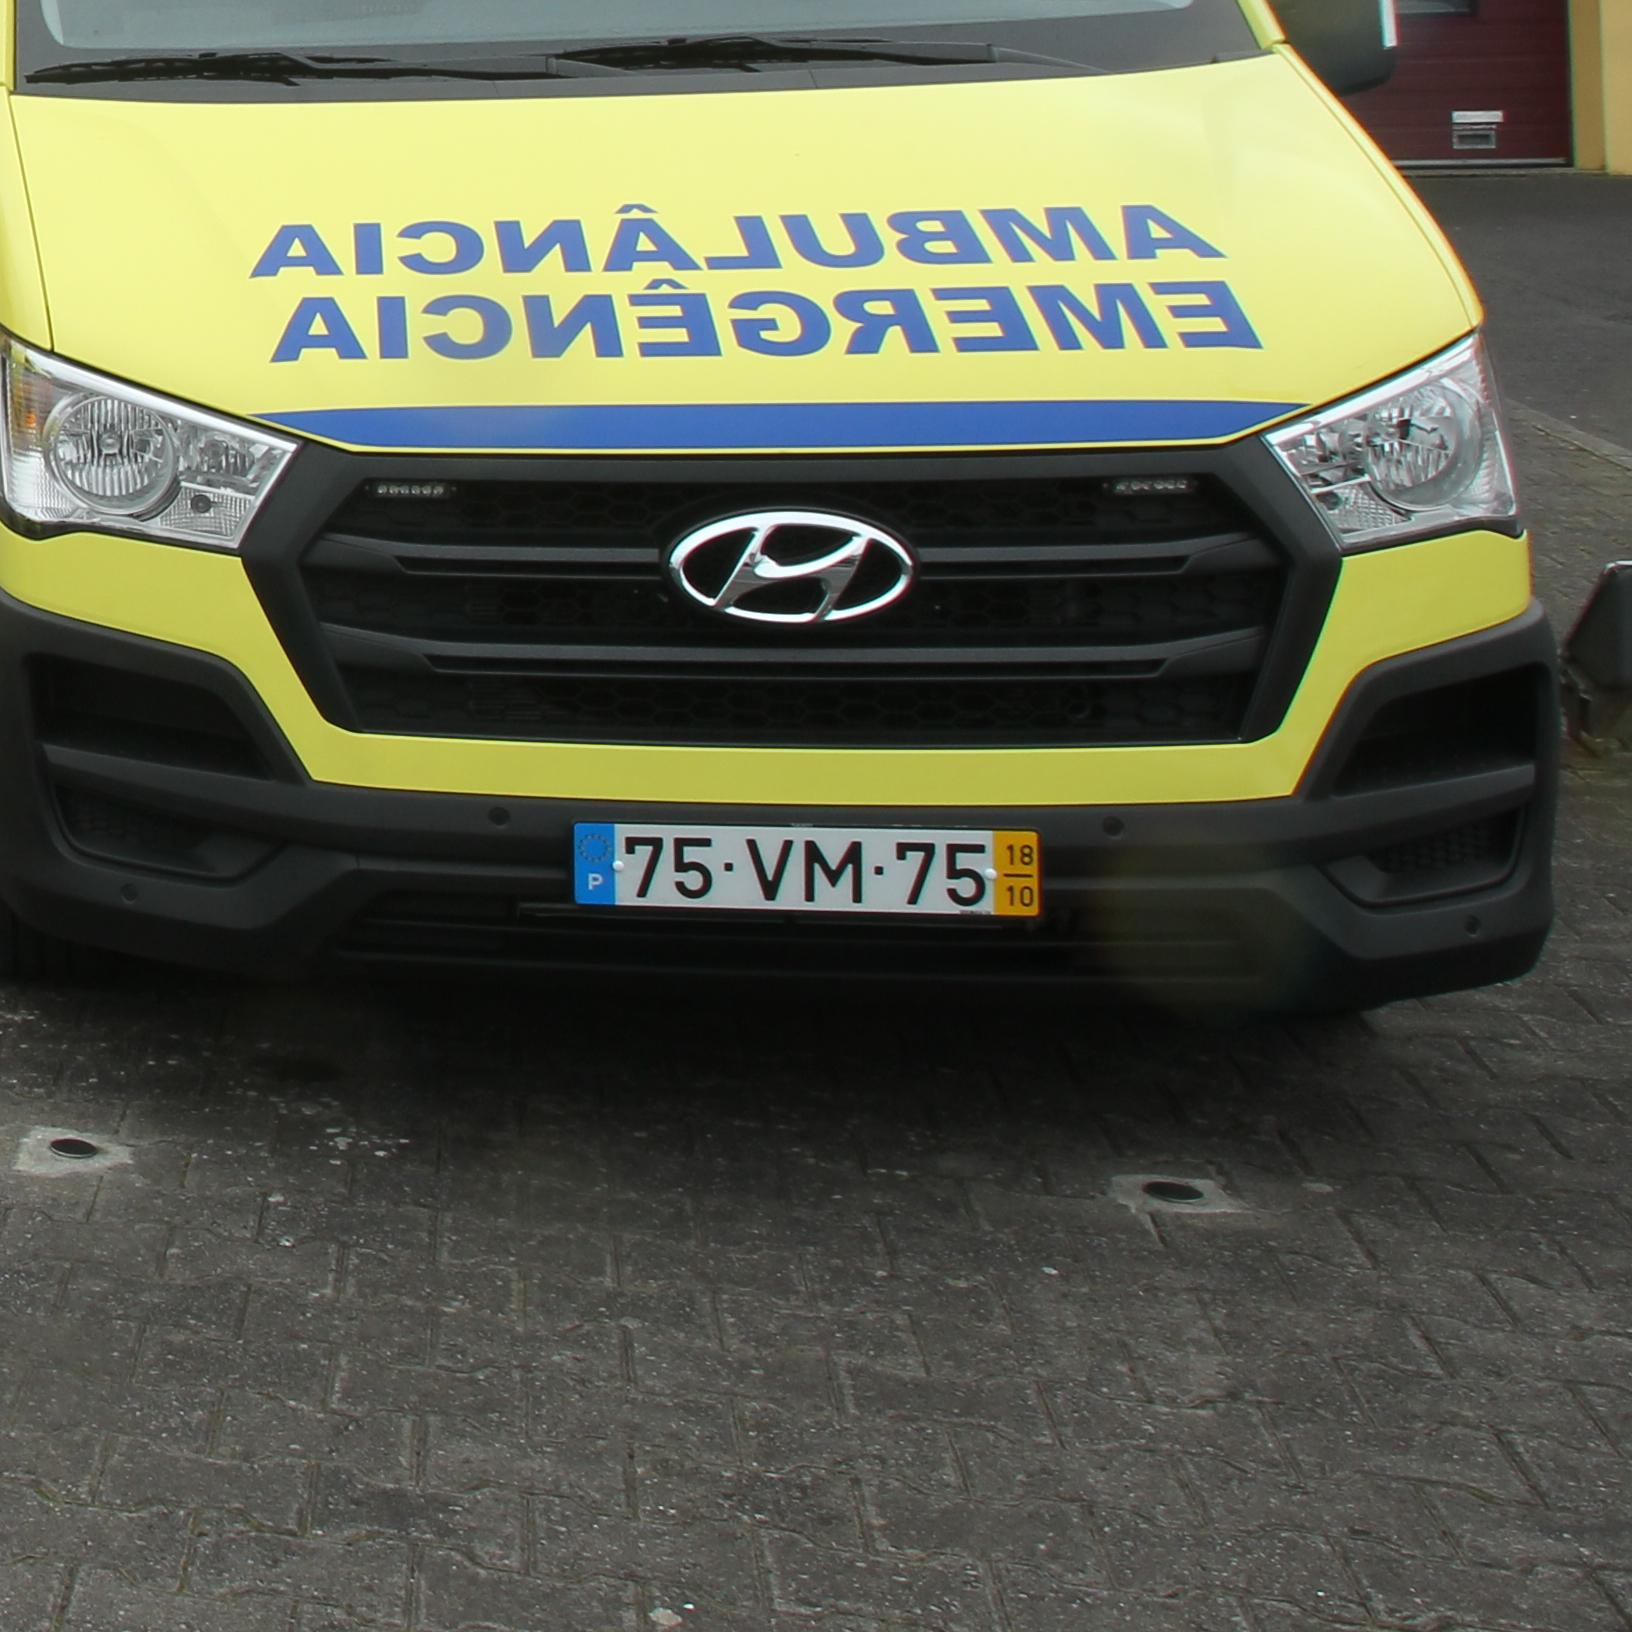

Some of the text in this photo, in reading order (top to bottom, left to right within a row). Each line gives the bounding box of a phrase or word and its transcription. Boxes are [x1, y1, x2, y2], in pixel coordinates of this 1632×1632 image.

[1006, 844, 1034, 866] 18
[588, 874, 604, 891] P
[1006, 885, 1034, 907] 10
